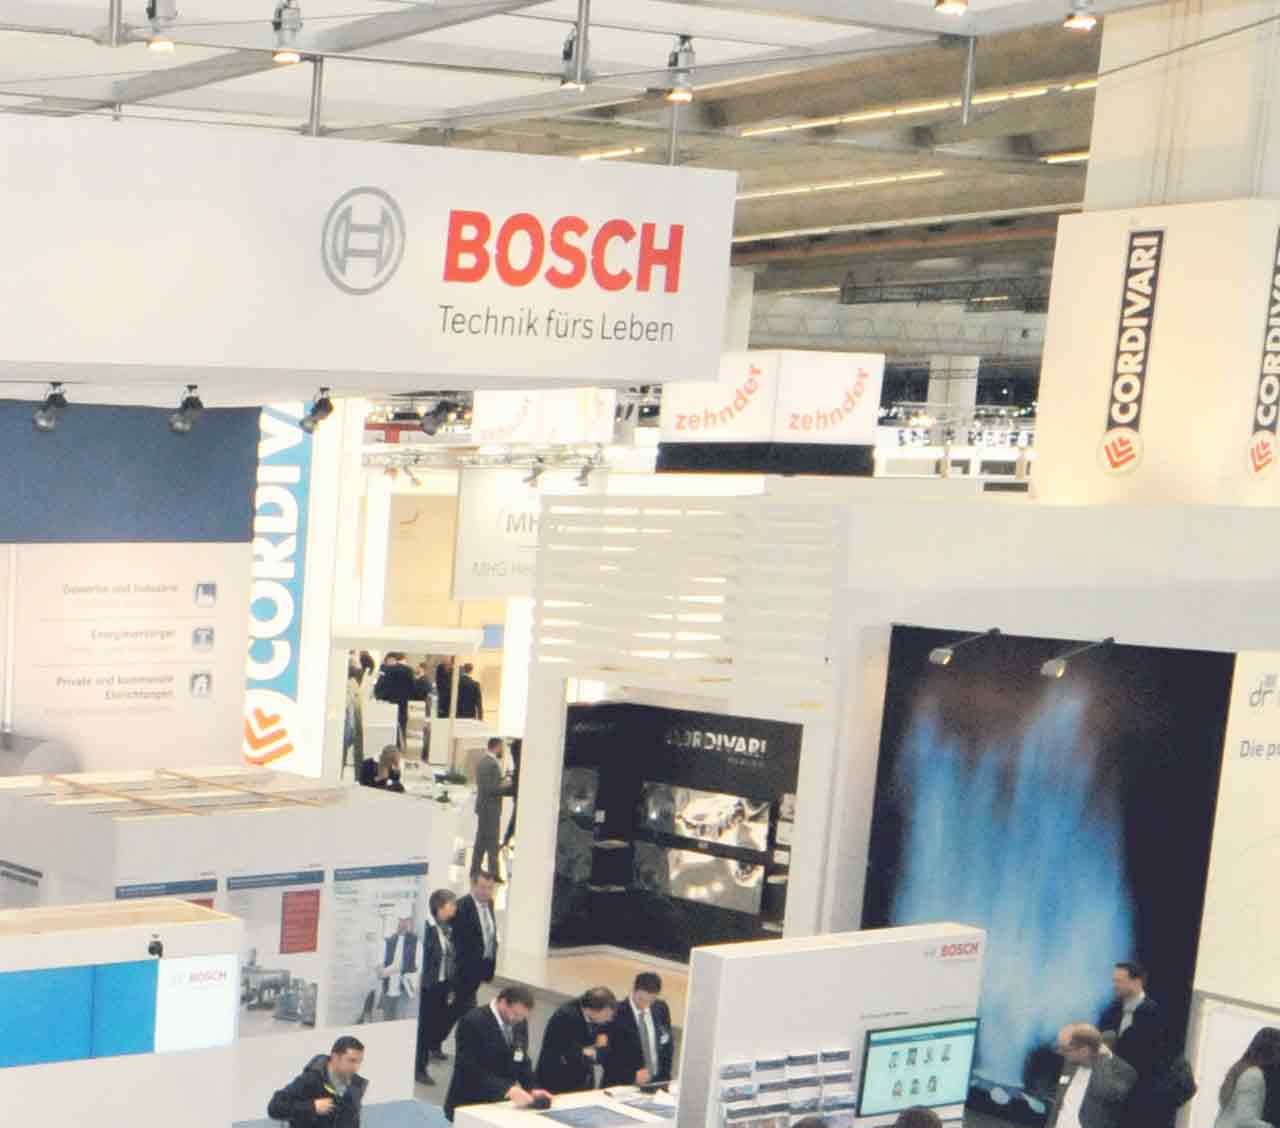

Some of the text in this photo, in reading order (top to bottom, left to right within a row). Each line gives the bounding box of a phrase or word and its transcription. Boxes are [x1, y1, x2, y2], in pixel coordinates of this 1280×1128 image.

[443, 209, 685, 293] BOSCH
[439, 304, 673, 342] Technik fürs Leben
[1111, 236, 1159, 424] CORDIVARI
[1256, 246, 1280, 427] CORDI
[674, 364, 762, 431] zehnder
[788, 367, 869, 432] zehnder
[506, 511, 544, 534] MH
